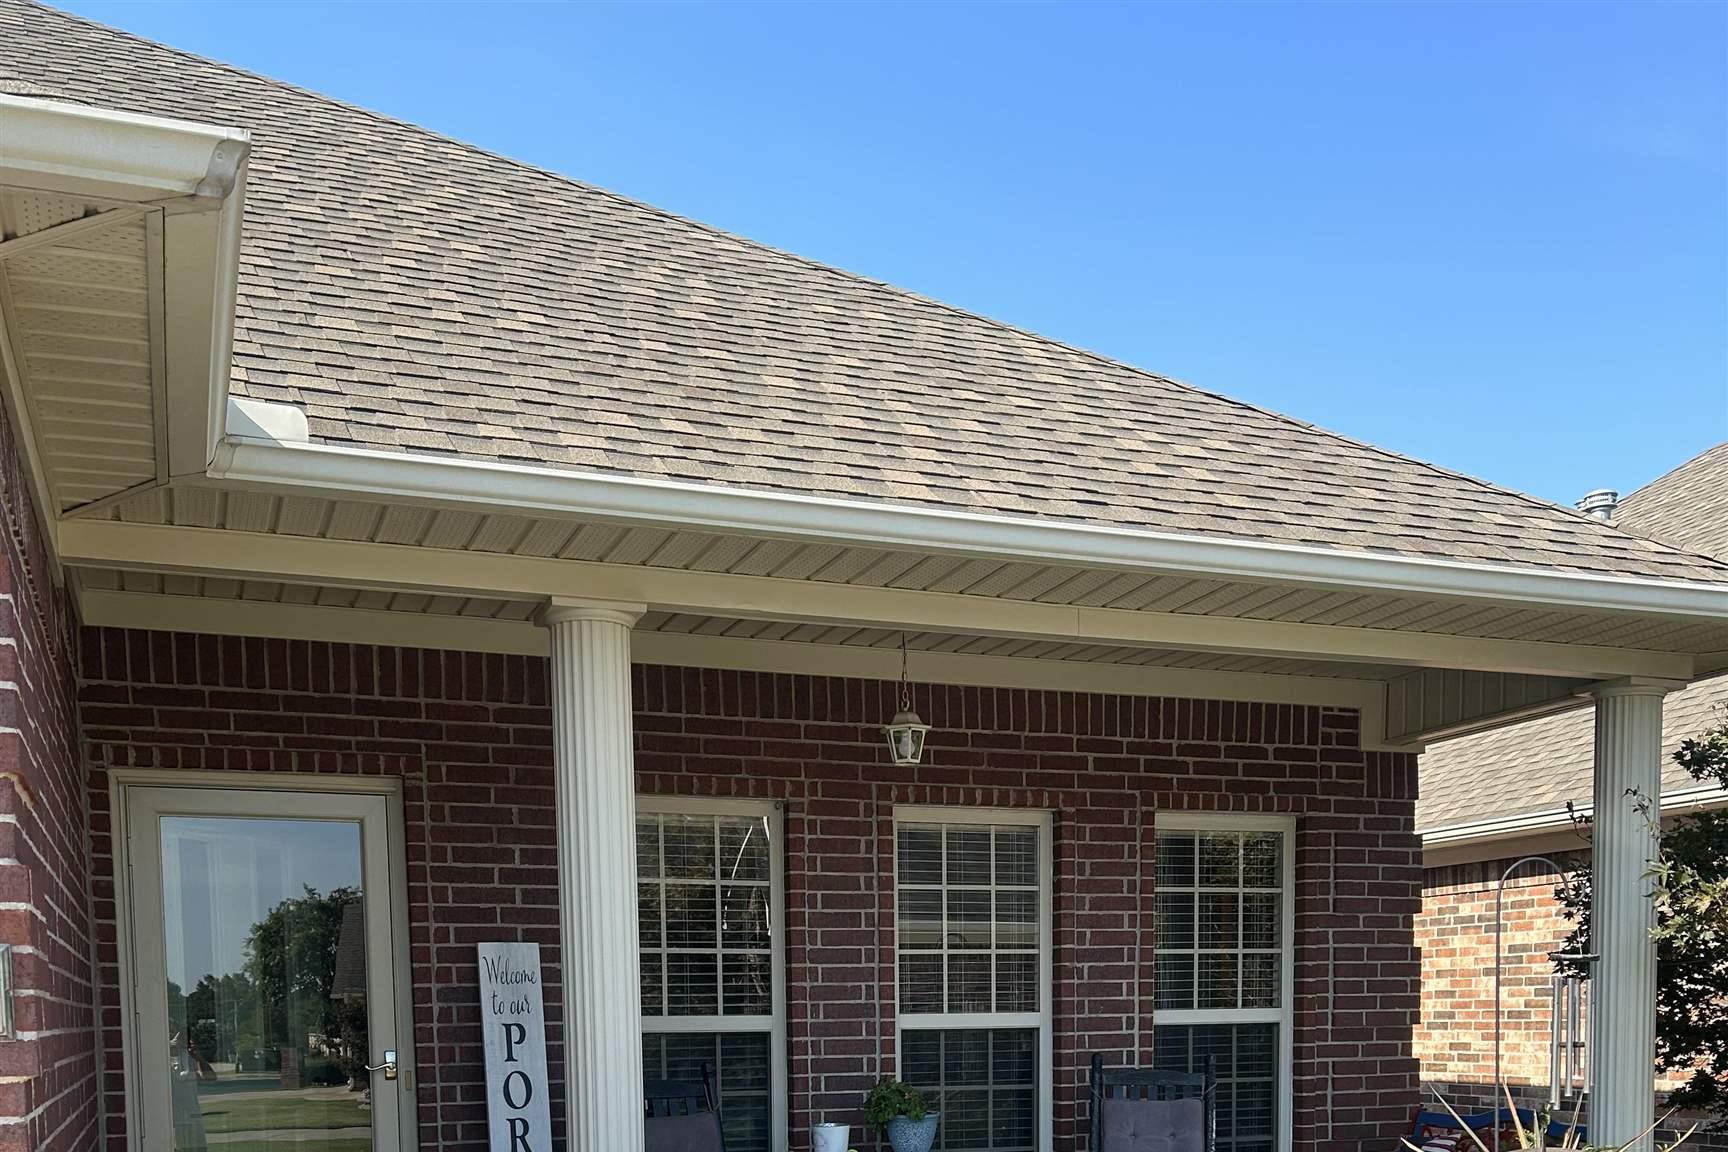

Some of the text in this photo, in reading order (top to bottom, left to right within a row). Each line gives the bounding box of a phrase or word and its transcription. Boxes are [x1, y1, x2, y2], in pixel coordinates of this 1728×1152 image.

[482, 955, 538, 985] Welcome
[491, 990, 531, 1015] to our
